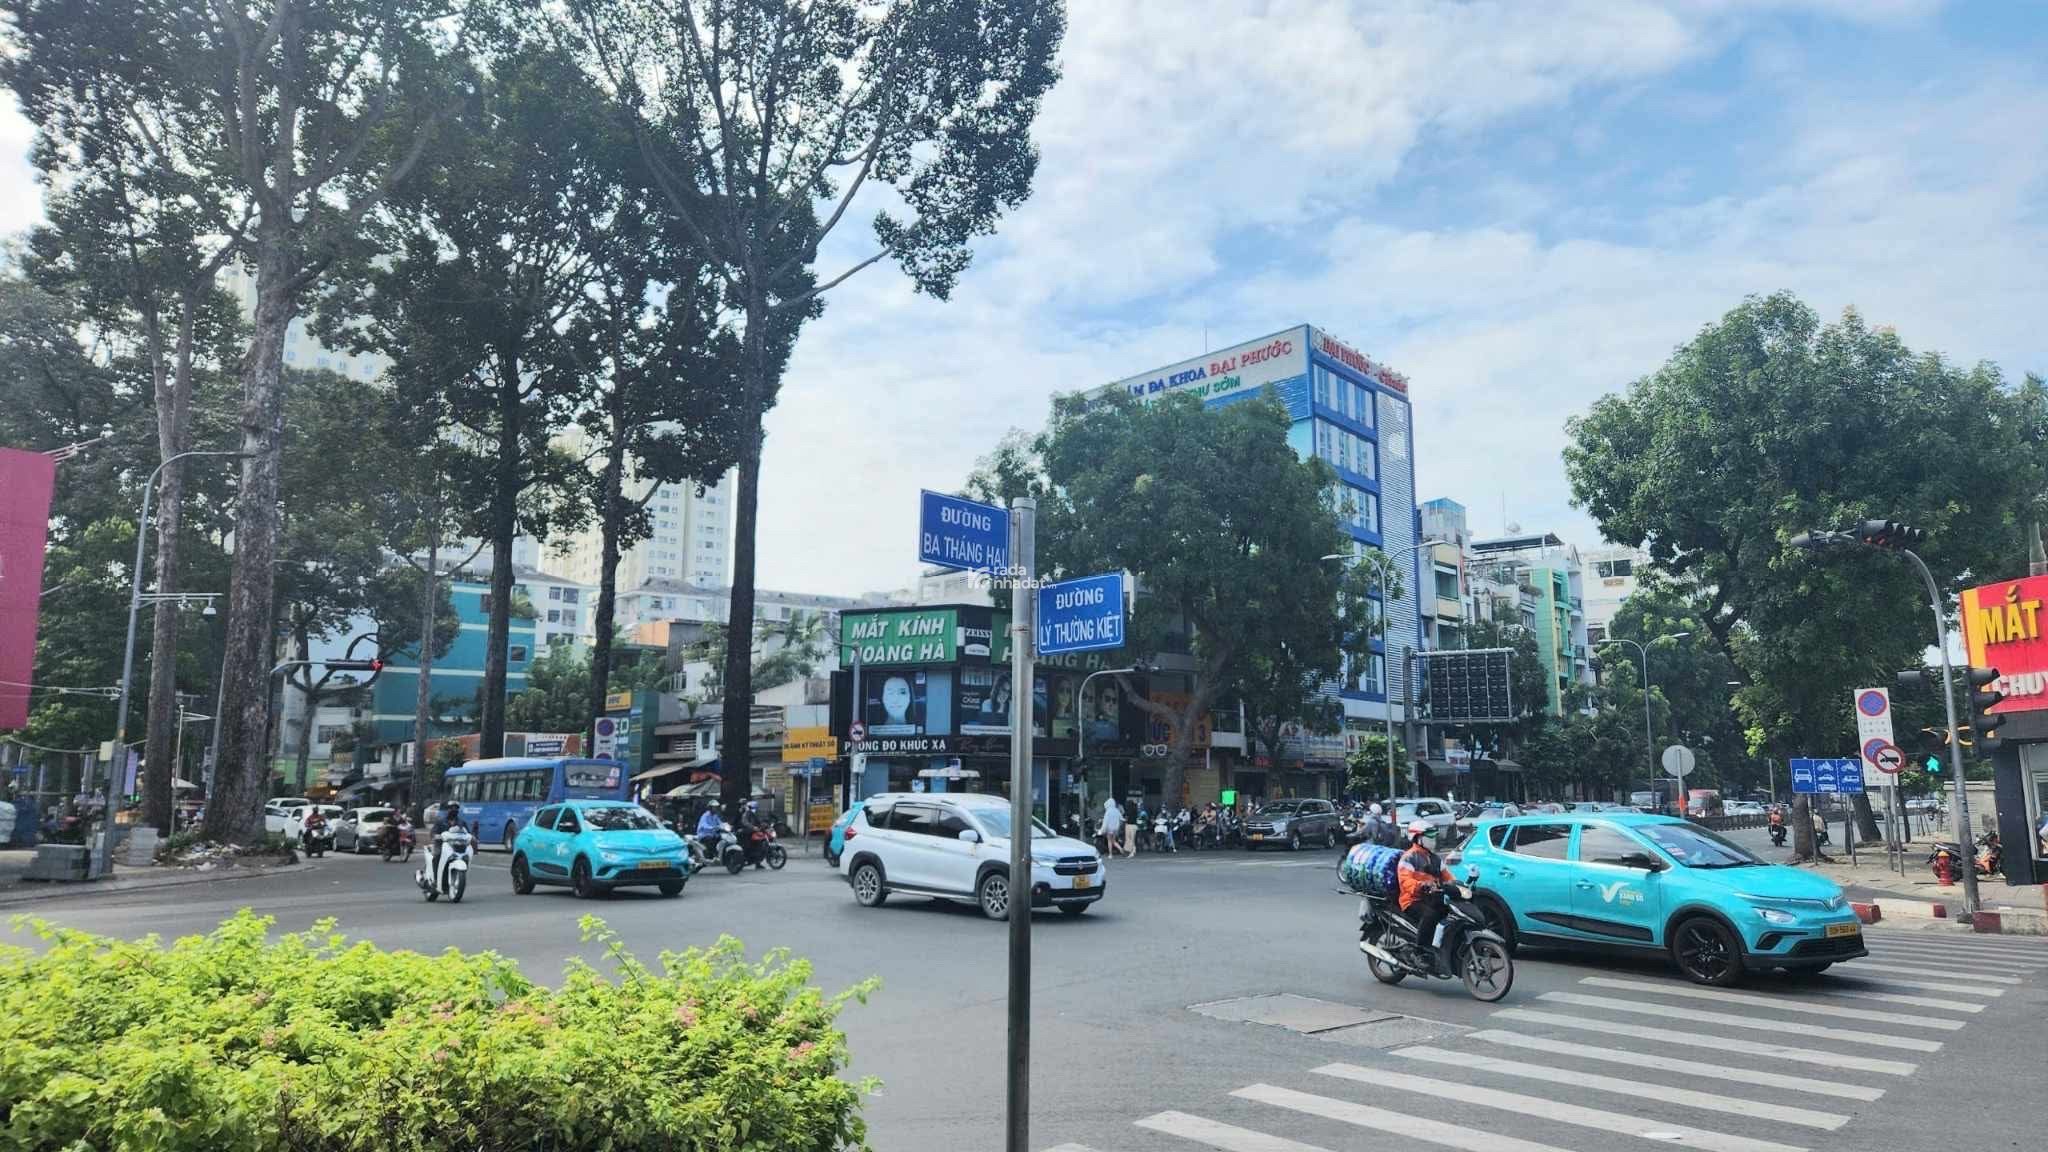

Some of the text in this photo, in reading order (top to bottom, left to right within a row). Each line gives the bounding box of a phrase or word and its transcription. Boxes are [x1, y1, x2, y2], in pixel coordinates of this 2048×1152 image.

[1169, 367, 1207, 388] KHOA
[1209, 357, 1236, 376] ĐẠI
[1240, 340, 1292, 367] PHƯỚC
[941, 507, 991, 532] ĐƯỜNG
[923, 532, 1007, 567] BA THÁNG HAI
[1056, 587, 1104, 610] ĐƯỜNG
[851, 614, 945, 639] MẮT KÍNH
[1979, 585, 2040, 645] MẮT
[1041, 619, 1052, 646] LÝ
[1055, 615, 1094, 645] THƯỜNG
[1096, 610, 1120, 641] KIỆT
[919, 638, 945, 660] HÀ
[882, 740, 897, 751] ĐO
[900, 736, 929, 750] KHÚC
[931, 739, 946, 752] XẠ
